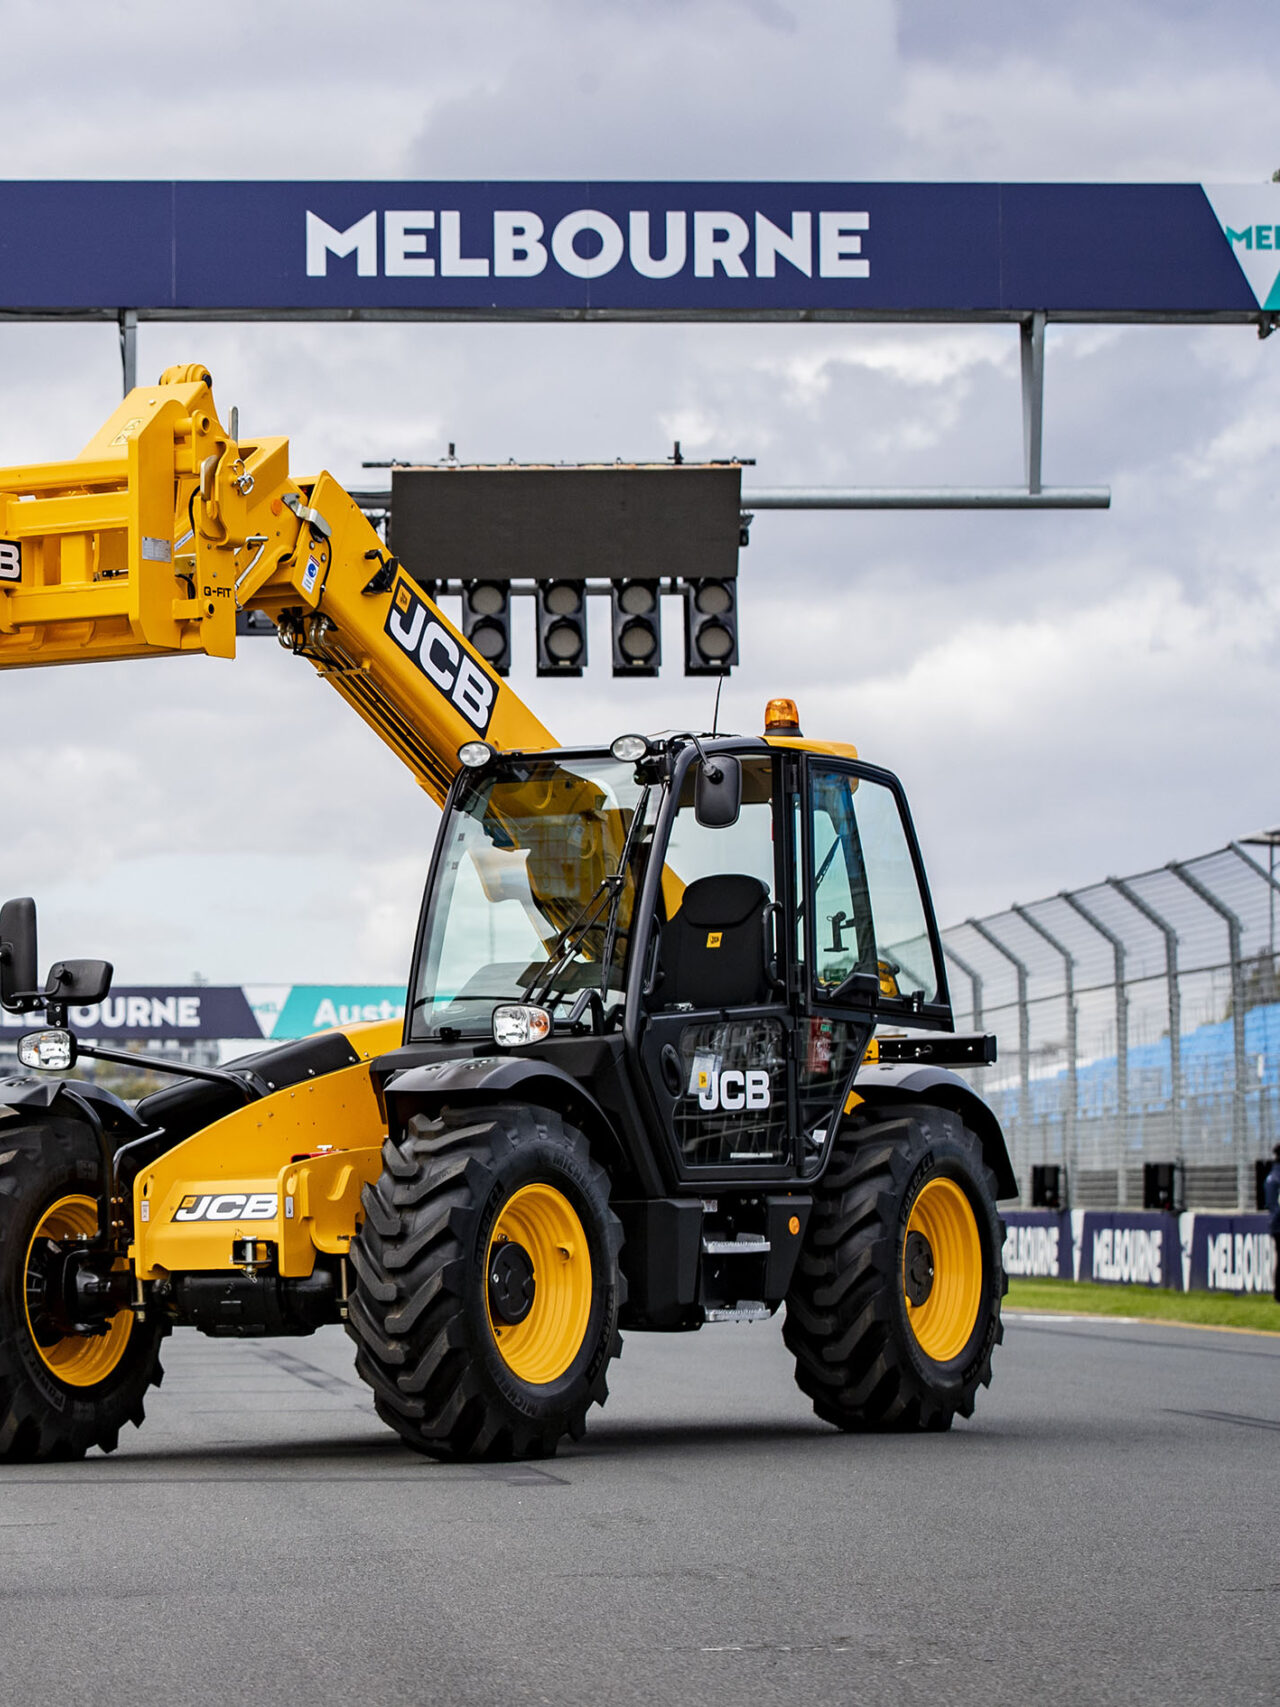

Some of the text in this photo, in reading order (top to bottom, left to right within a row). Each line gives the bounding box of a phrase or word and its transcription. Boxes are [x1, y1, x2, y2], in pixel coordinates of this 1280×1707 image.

[305, 209, 871, 279] MELBOURNE
[390, 603, 494, 729] JCB
[698, 1070, 771, 1111] JCB
[175, 1194, 278, 1221] JCB
[1092, 1228, 1163, 1284] MELBOURNE
